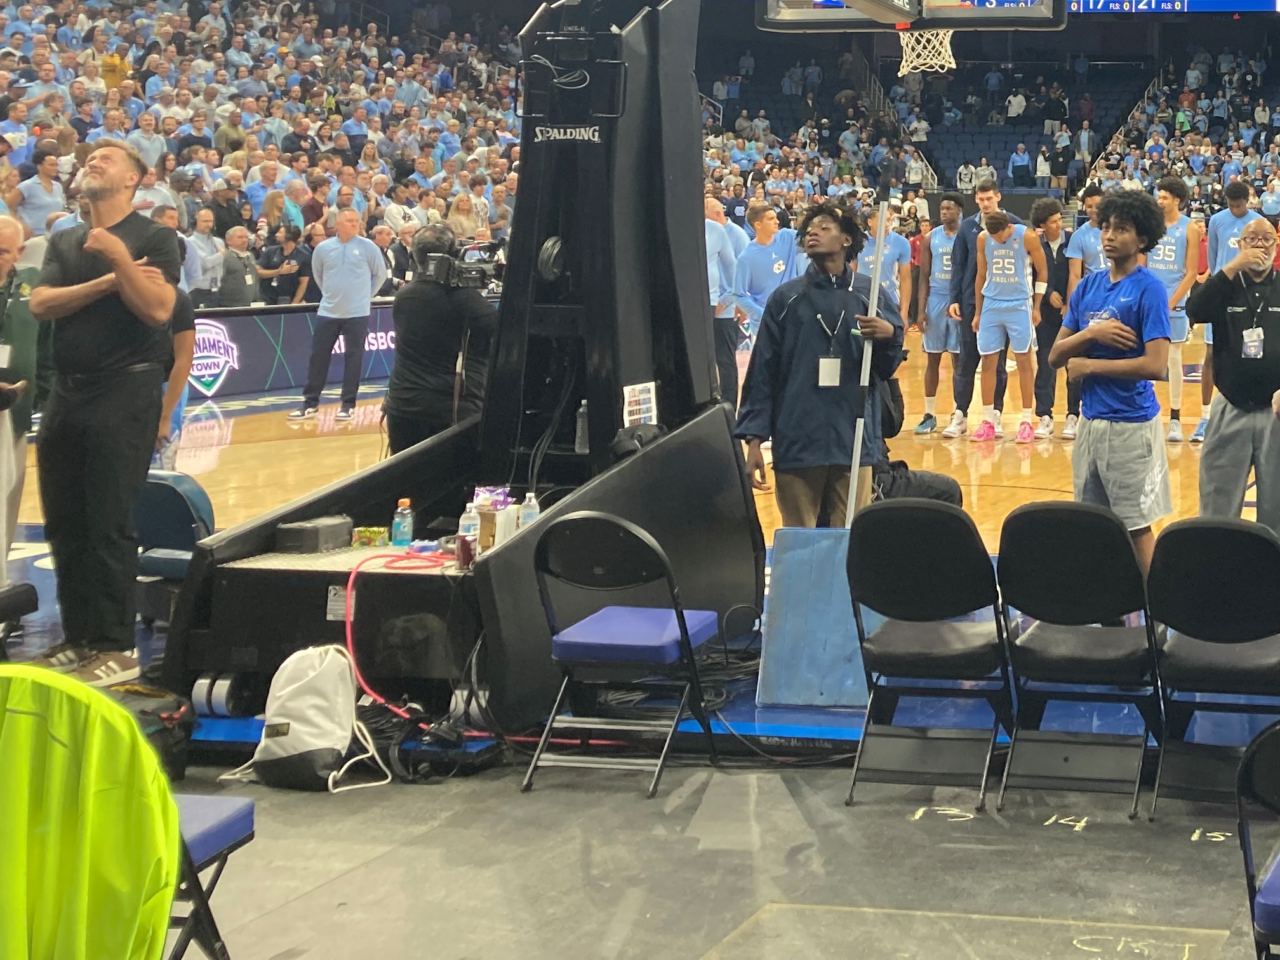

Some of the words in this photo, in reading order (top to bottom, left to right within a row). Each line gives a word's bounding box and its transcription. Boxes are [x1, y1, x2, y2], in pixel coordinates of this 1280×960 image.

[534, 126, 600, 143] SPALDING
[1153, 245, 1176, 261] 35
[992, 258, 1015, 274] 25
[1149, 261, 1178, 270] CAROLINA
[195, 337, 235, 365] NAMENT
[191, 361, 220, 372] TOWN
[1043, 814, 1089, 832] 14
[1191, 828, 1233, 842] 15
